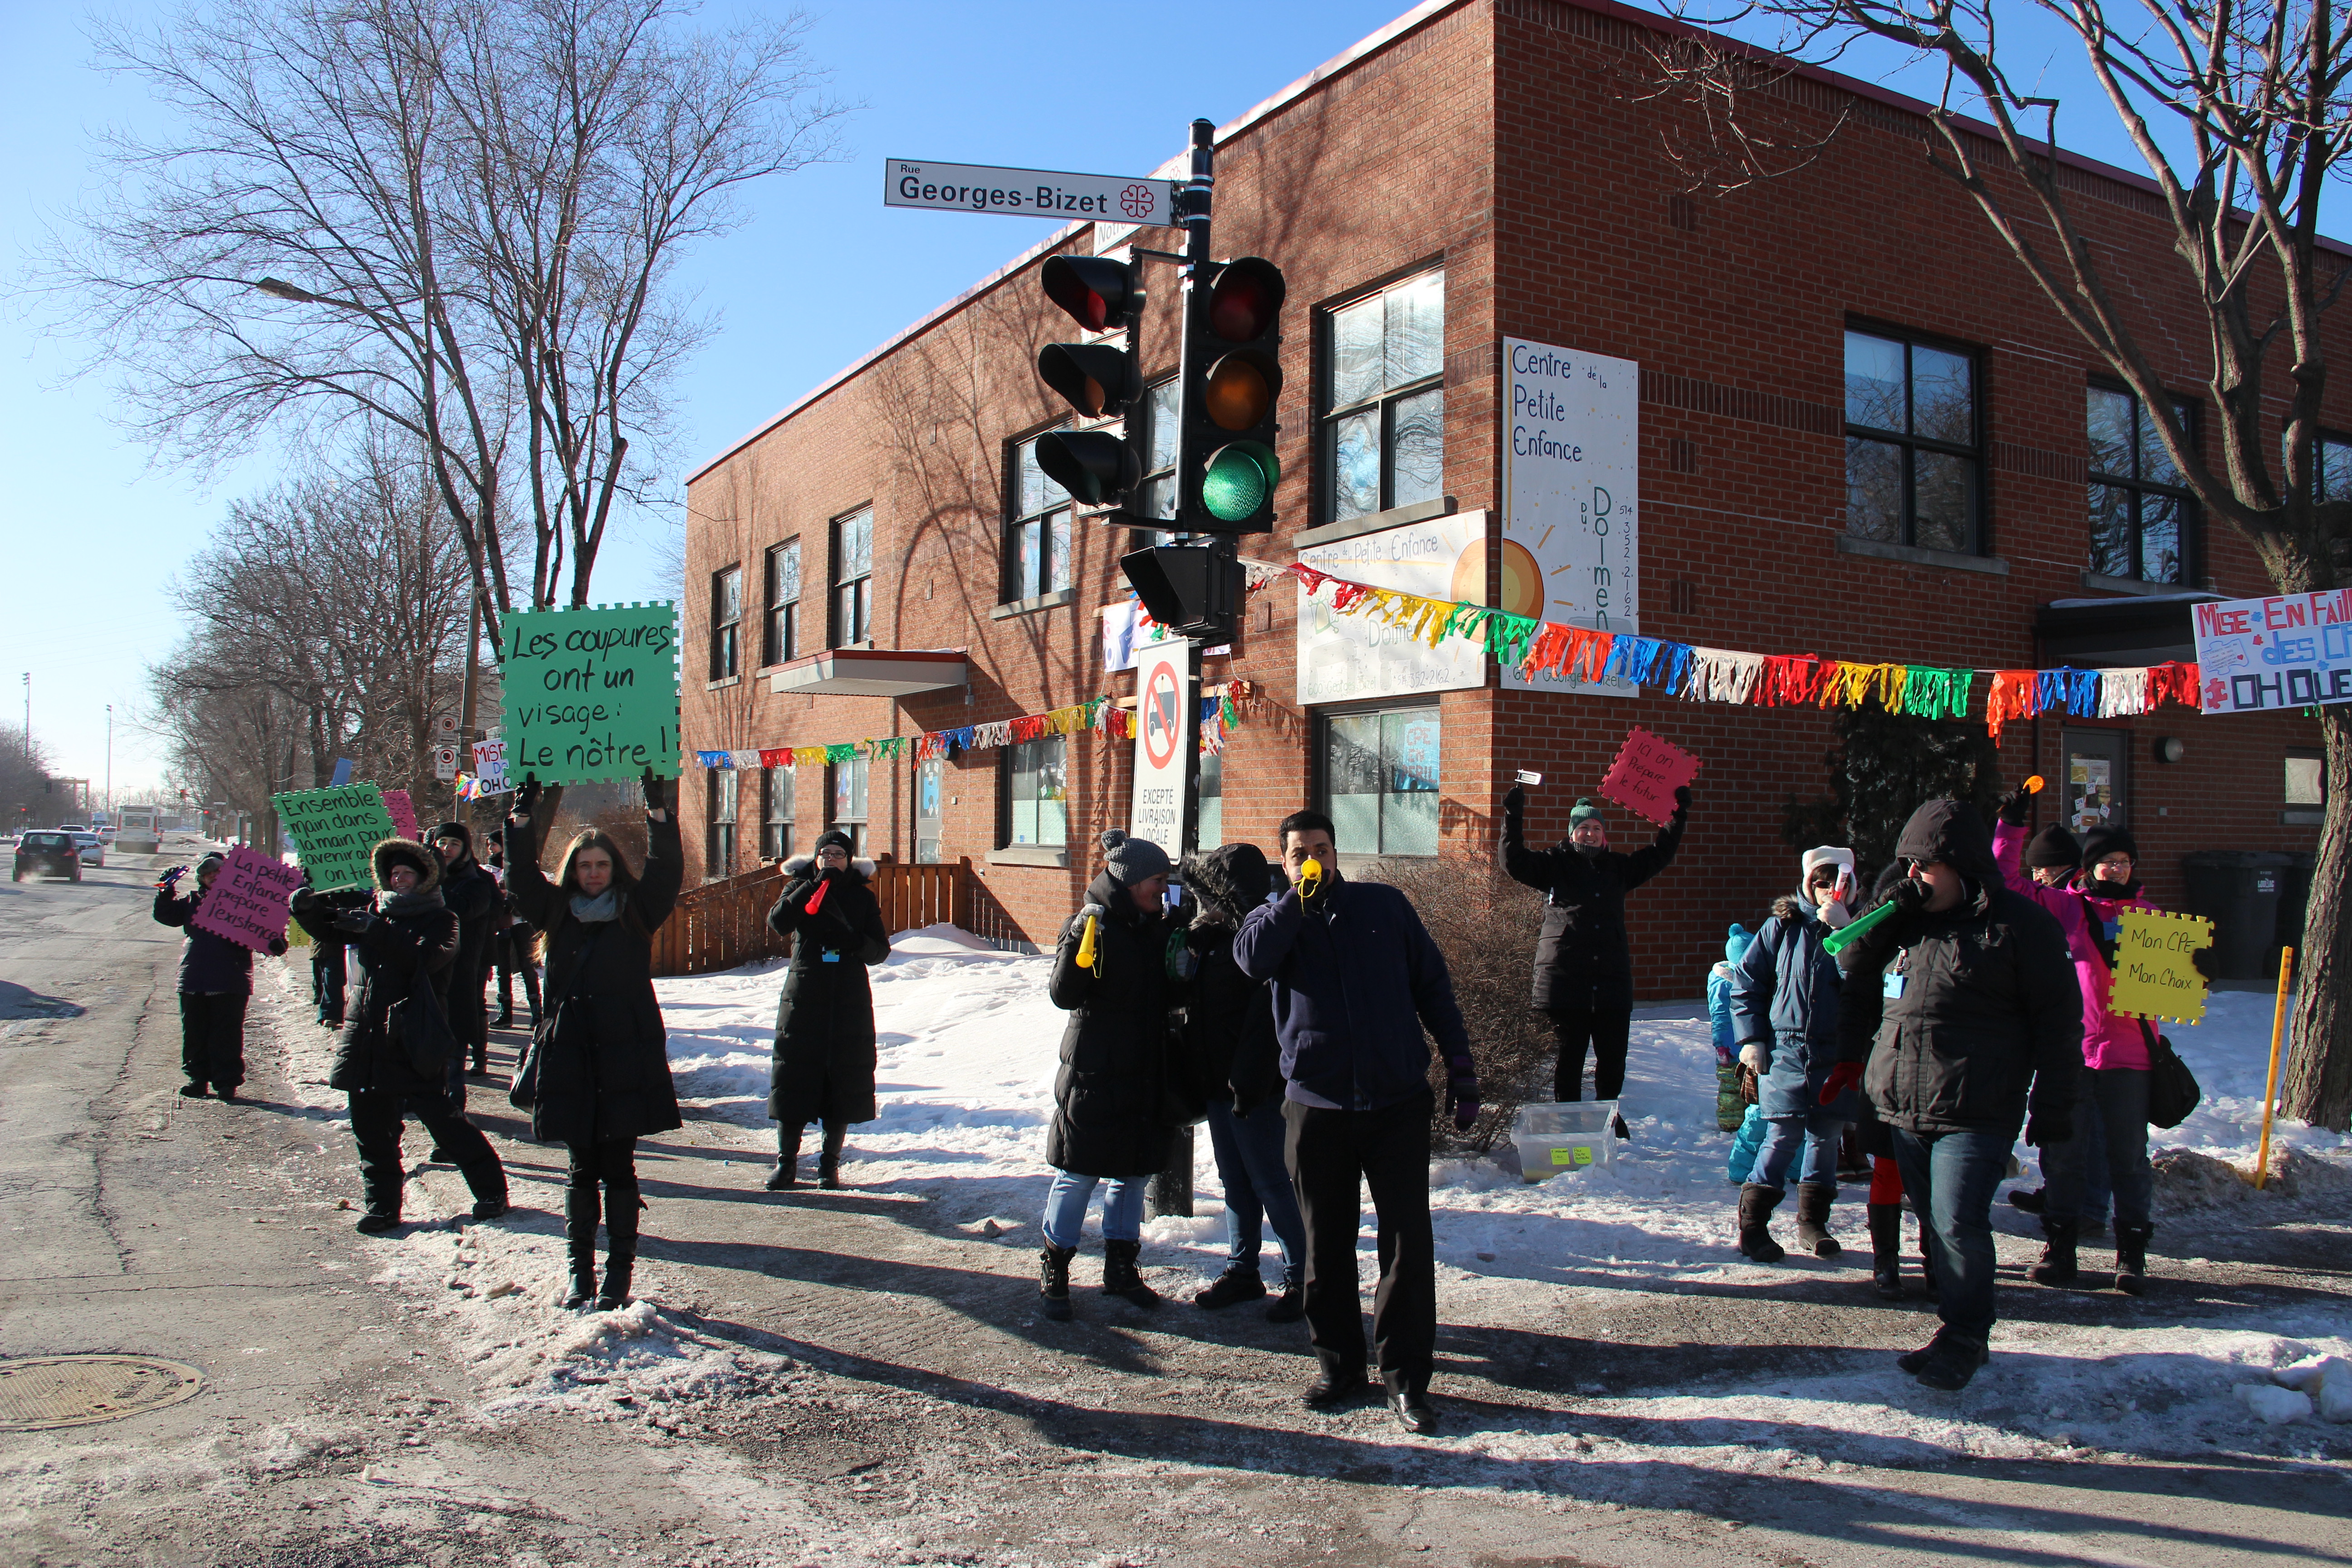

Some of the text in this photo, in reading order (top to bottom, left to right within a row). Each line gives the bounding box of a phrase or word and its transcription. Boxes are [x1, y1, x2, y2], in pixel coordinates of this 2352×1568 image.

[901, 164, 920, 173] Rue
[899, 176, 1107, 213] Georges-Bizet
[1512, 345, 1607, 388] Centre de la
[1515, 384, 1565, 421] Petite
[1514, 426, 1581, 462] Enfance
[1300, 547, 1338, 571] Centre
[1355, 539, 1382, 568] Petite
[1391, 532, 1438, 562] Enfance
[1594, 486, 1611, 630] Dolmen
[512, 625, 670, 662] Les coupures
[544, 659, 634, 692] ont un
[1308, 683, 1323, 696] 600
[2230, 672, 2283, 710] OH
[520, 738, 554, 766] Le
[1656, 754, 1673, 768] on
[1143, 786, 1173, 804] EXCEPTÉ
[1619, 774, 1660, 801] le futur
[281, 789, 381, 817] Ensemble,
[290, 812, 378, 838] main dans
[1138, 809, 1176, 826] LIVRAISON
[298, 828, 392, 852] la main pour
[1143, 828, 1168, 844] LOCALE
[234, 854, 252, 874] La
[305, 851, 353, 865] avenir
[232, 874, 289, 906] Enfance
[2132, 928, 2195, 953] Mon CPE
[2129, 963, 2192, 990] Mon Choix
